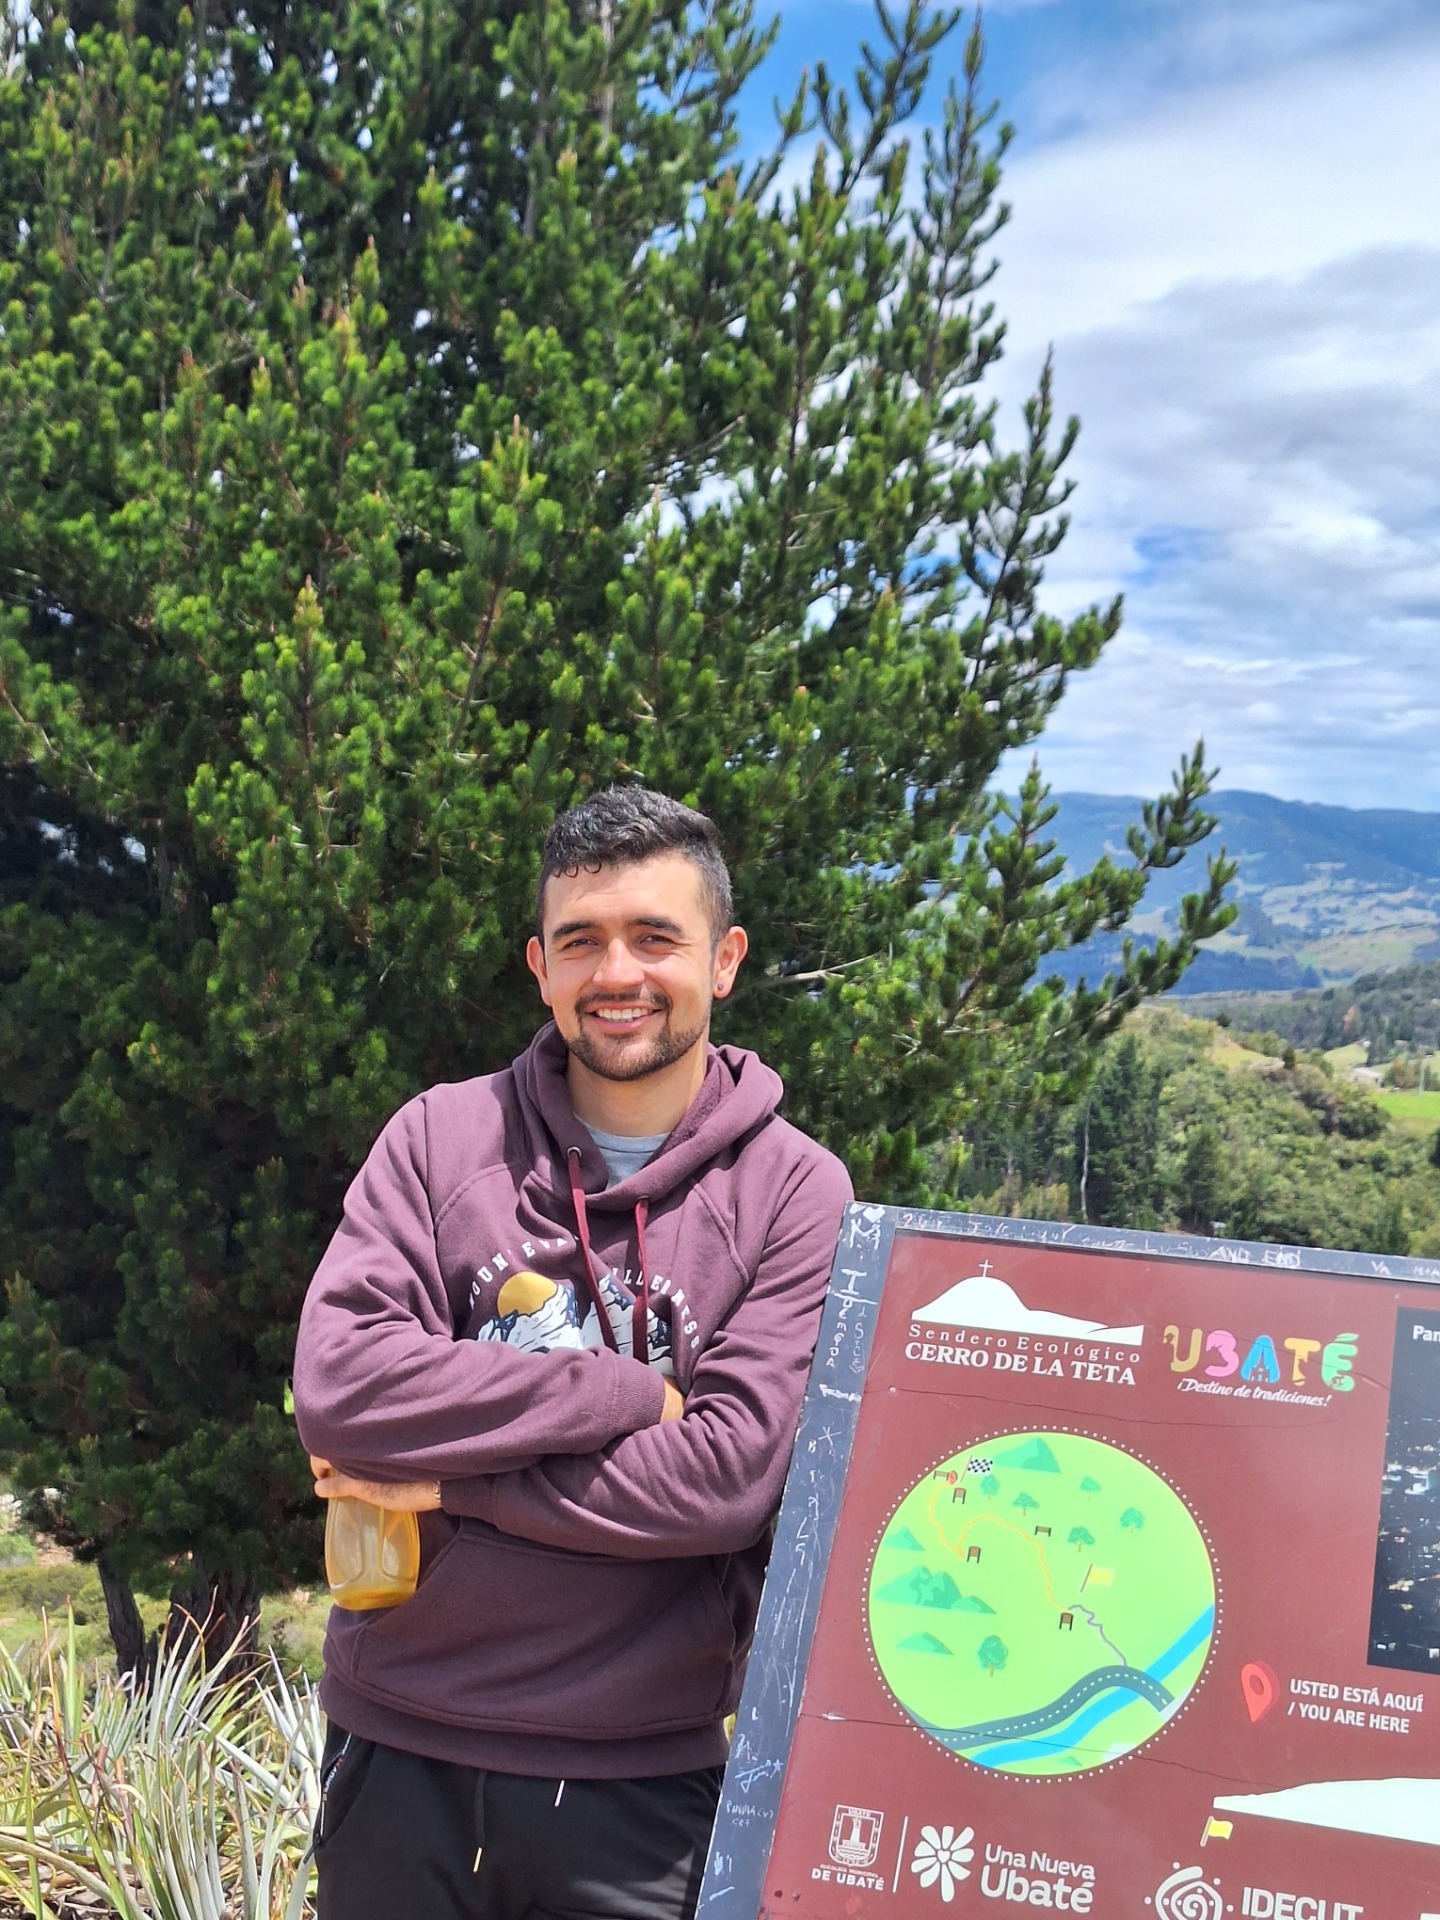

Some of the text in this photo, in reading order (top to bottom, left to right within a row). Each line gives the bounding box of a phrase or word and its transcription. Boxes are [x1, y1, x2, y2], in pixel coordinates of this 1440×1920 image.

[909, 1323, 1140, 1363] Sendero Ecológico
[1163, 1324, 1359, 1392] UBATÉ
[905, 1341, 1137, 1386] CERRO DE LA TETA
[1177, 1377, 1233, 1397] ¡Destino
[1233, 1384, 1252, 1399] de
[1290, 1678, 1424, 1713] USTED ESTÁ AQUÍ
[1287, 1701, 1410, 1734] / YOU ARE HERE
[811, 1868, 885, 1891] DE UBATÉ
[985, 1843, 1096, 1880] Una Nueva
[981, 1864, 1095, 1913] Ubaté
